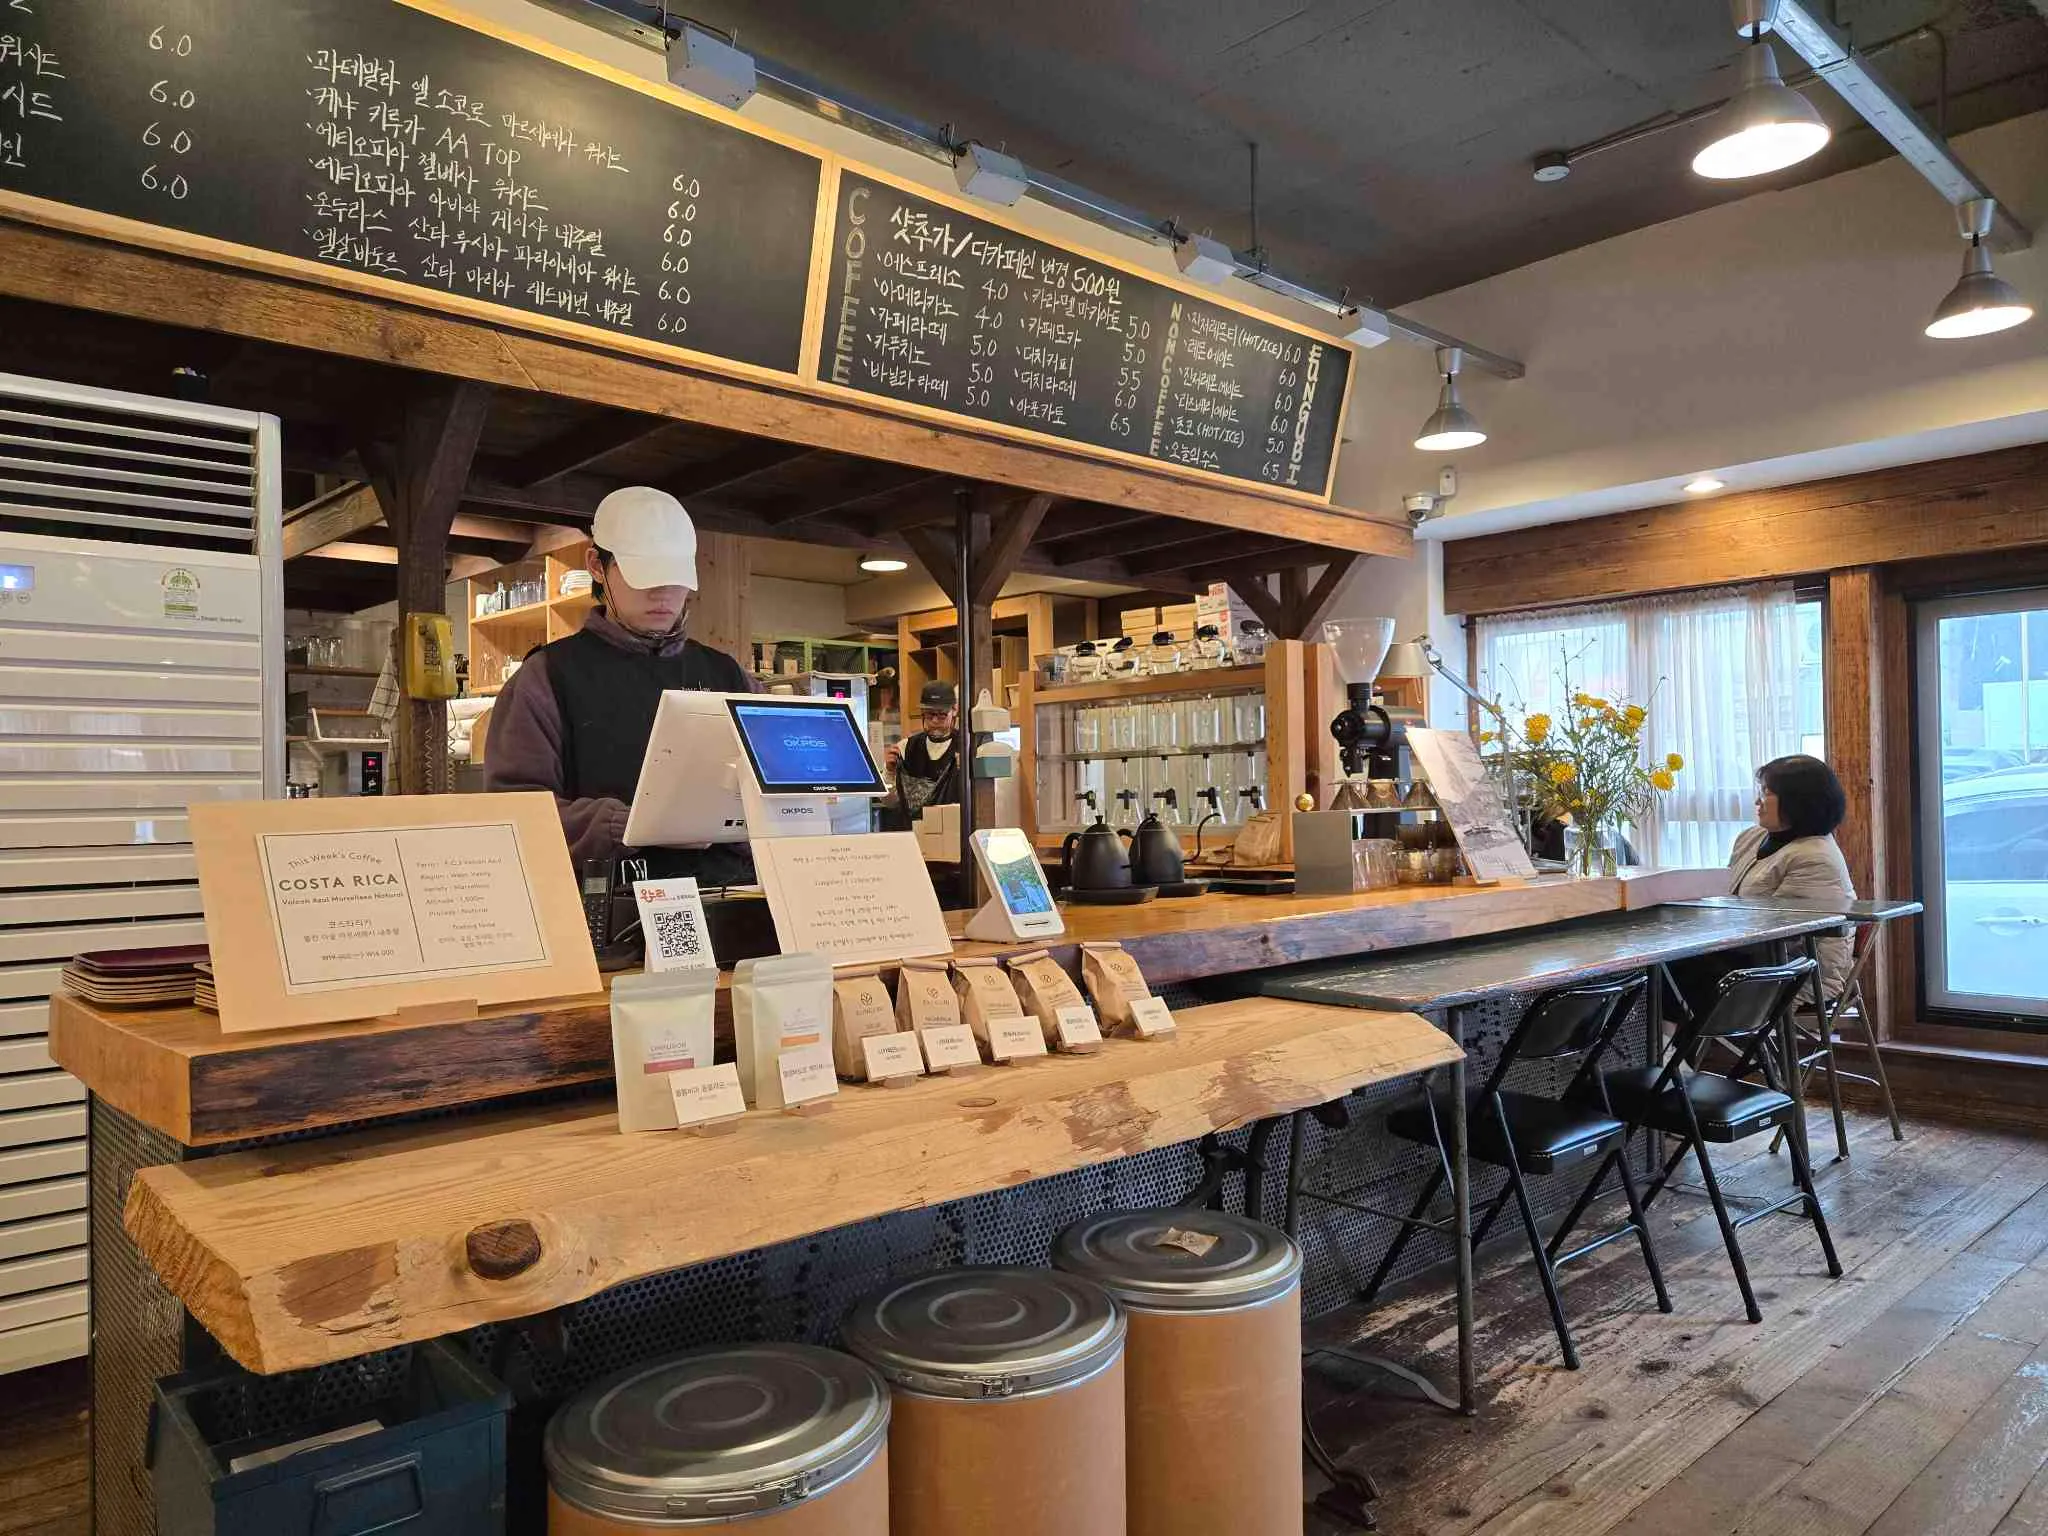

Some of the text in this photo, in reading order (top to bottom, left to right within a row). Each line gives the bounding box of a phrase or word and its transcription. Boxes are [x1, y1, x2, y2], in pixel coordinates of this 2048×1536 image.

[149, 26, 192, 56] 6.0
[150, 81, 196, 108] 6.0
[143, 122, 191, 153] 6.0
[313, 49, 401, 97] 과테말라
[435, 89, 493, 127] 소코로
[673, 174, 700, 198] 6.0
[314, 87, 360, 120] 케냐
[368, 101, 426, 146] 키루가
[436, 127, 469, 160] AA
[668, 201, 696, 221] 6.0
[141, 165, 188, 199] 6.0
[316, 121, 410, 172] 에티오피아
[489, 178, 549, 211] 워시드
[663, 224, 692, 247] 6.0
[314, 156, 416, 207] 에티오피아
[428, 187, 481, 223] 아바야
[490, 208, 549, 243] 게이샤
[661, 252, 689, 273] 6.0
[312, 191, 392, 233] 온두라스
[408, 217, 449, 248] 산타
[453, 231, 508, 262] 루시아
[513, 246, 597, 284] 파라이네마
[659, 281, 690, 304] 6.0
[313, 227, 407, 276] 엘살바도르
[421, 252, 456, 289] 산타
[466, 266, 515, 299] 마리아
[657, 313, 687, 333] 6.0
[832, 186, 872, 384] COFFEE
[883, 252, 1009, 301] 에스프레소 4.0
[1041, 257, 1070, 289] 변경
[1071, 267, 1122, 305] 500원
[880, 280, 1002, 329] 아메리카노 4.0
[878, 308, 997, 357] 카페라떼 5.0
[1028, 317, 1146, 364] 카페모카 5.0
[1126, 316, 1150, 340] 5.0
[873, 333, 993, 384] 카푸치노 5.0
[1023, 346, 1074, 379] 더치커피
[1187, 338, 1296, 387] 레몬에이드 6.0
[1284, 343, 1301, 364] 6.0
[965, 386, 990, 407] 5.0
[1021, 371, 1137, 409] 더치라떼 6.0
[1274, 393, 1292, 412] 6.0
[1270, 415, 1288, 434] 6.0
[1266, 437, 1284, 454] 5.0
[781, 807, 815, 815] OKPOS
[288, 857, 310, 869] This
[348, 852, 383, 864] Coffee
[279, 874, 399, 892] COSTA RICA
